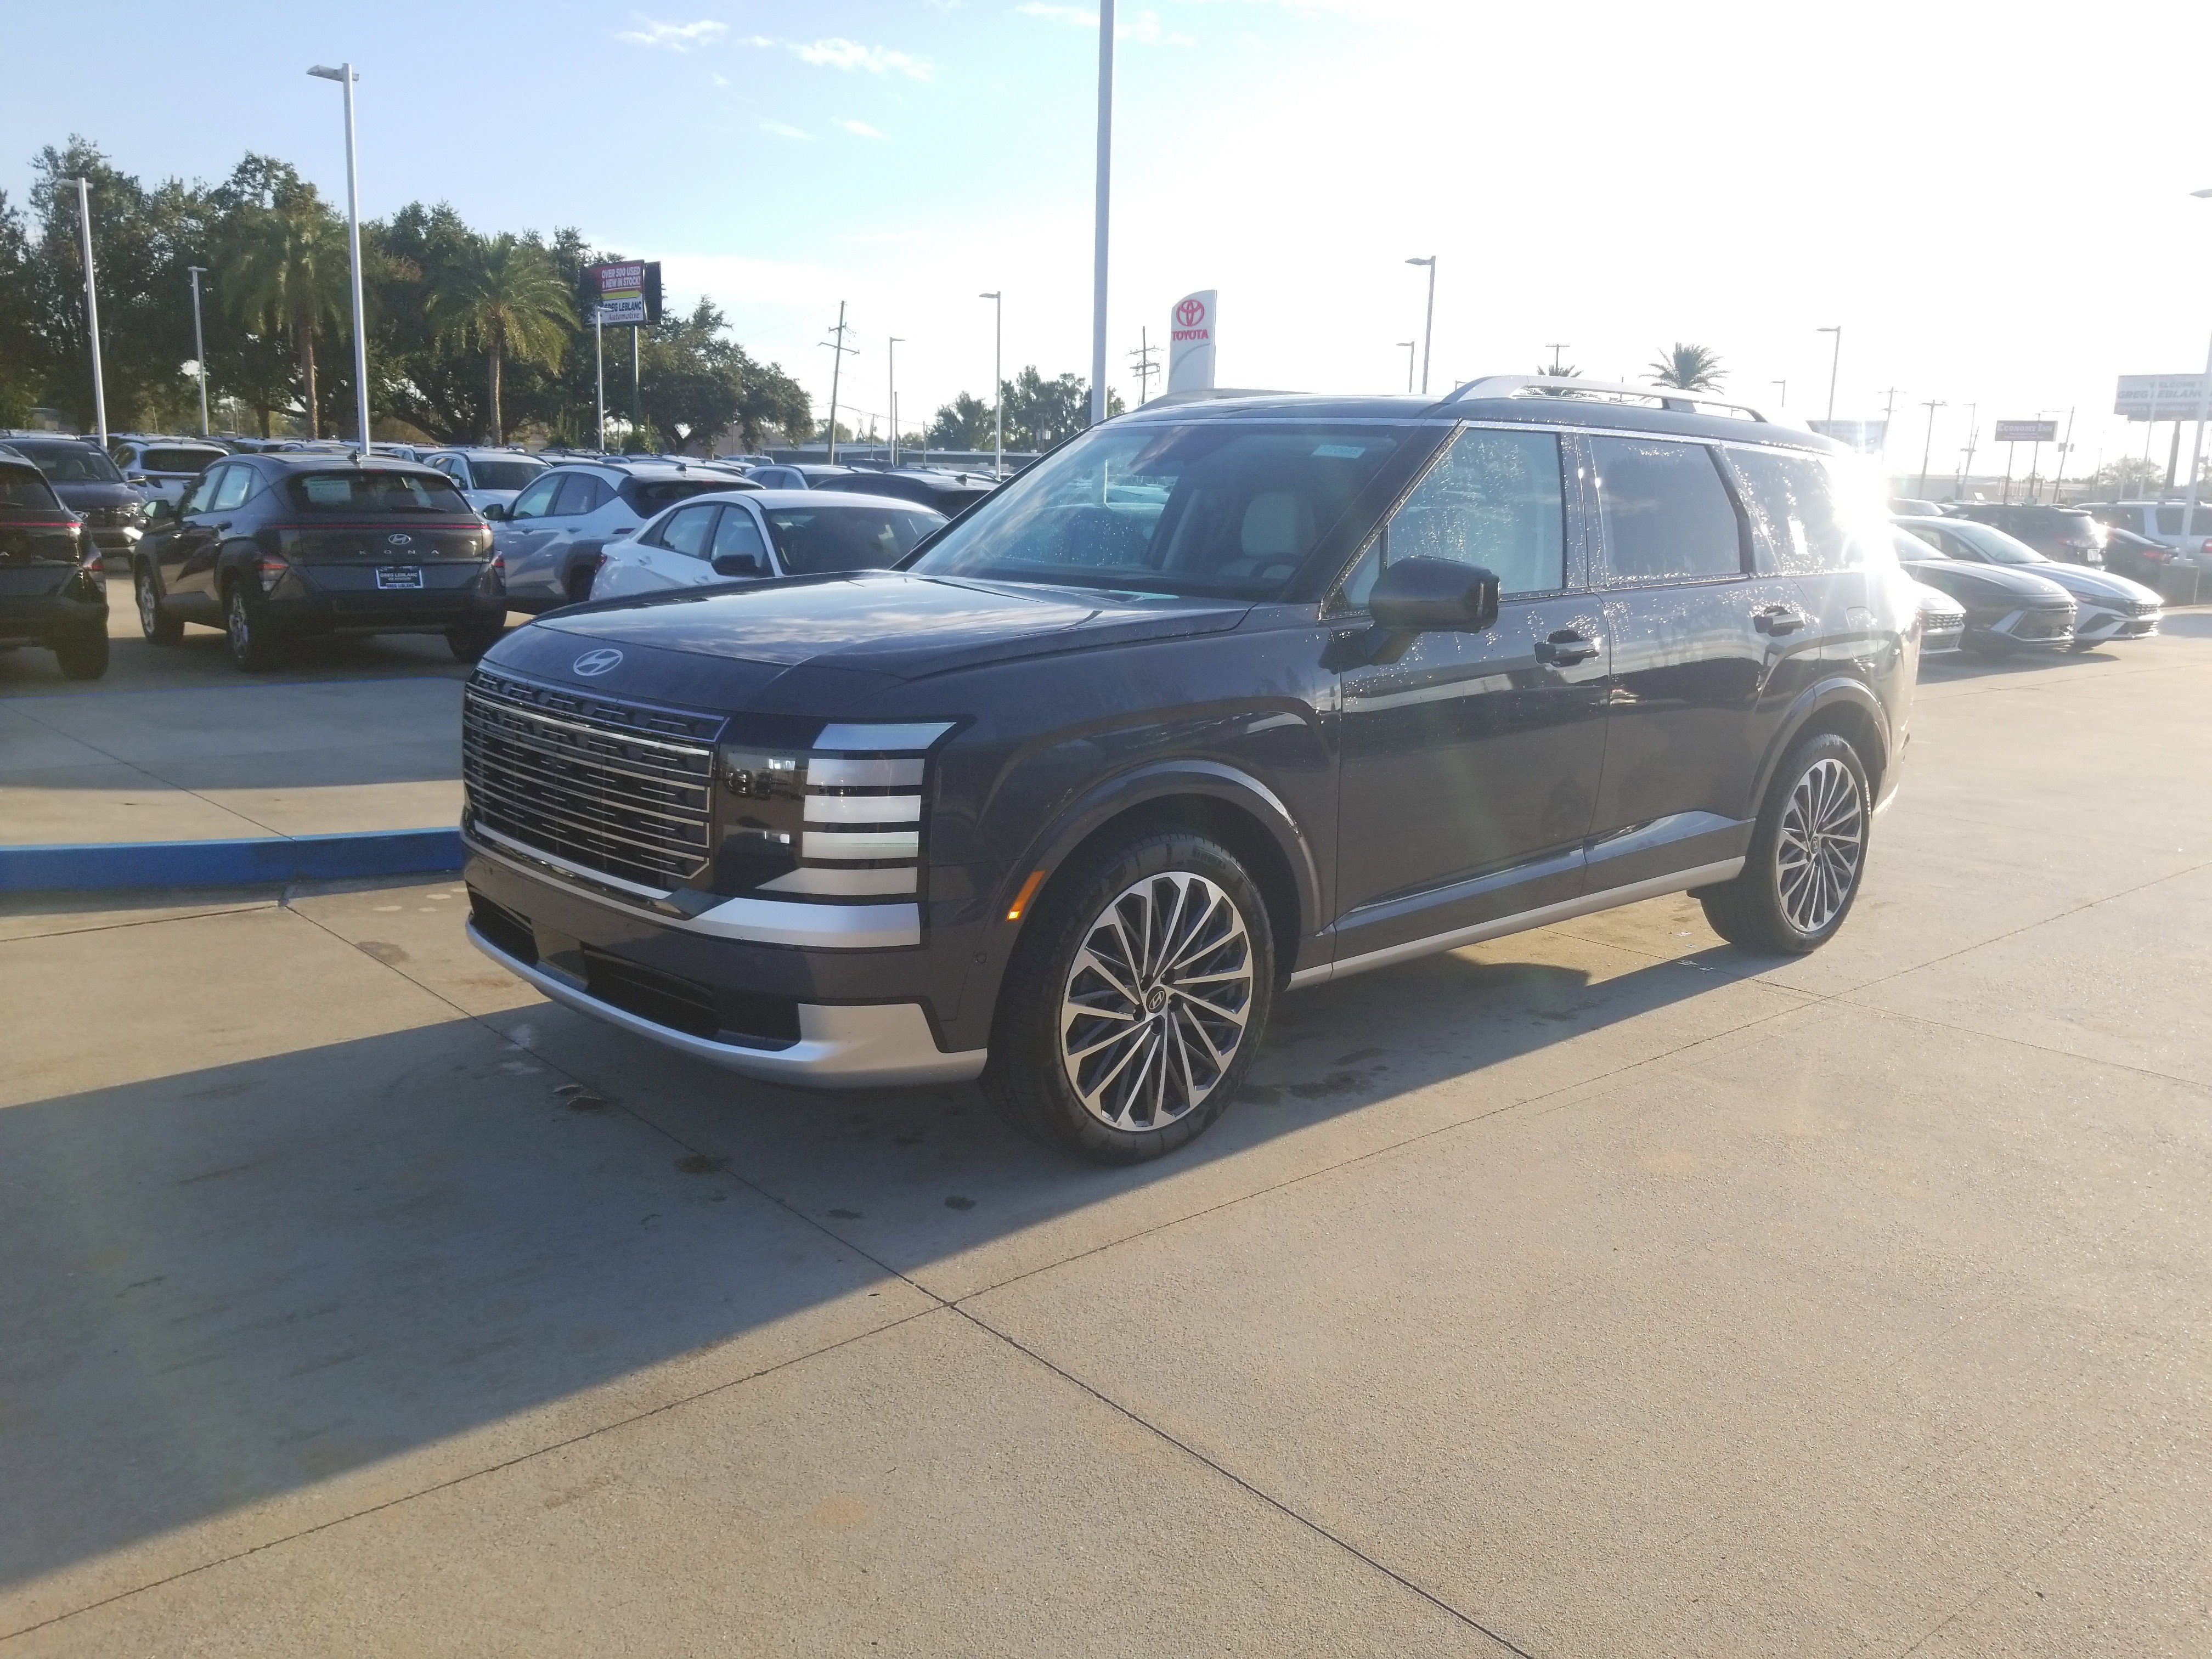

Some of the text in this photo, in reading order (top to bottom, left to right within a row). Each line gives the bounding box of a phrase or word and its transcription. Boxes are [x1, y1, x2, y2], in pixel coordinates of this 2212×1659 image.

[601, 268, 615, 279] OVER
[627, 266, 640, 276] USED
[605, 278, 617, 288] NEW
[617, 278, 623, 287] IN
[619, 301, 641, 312] LEBLANC
[1171, 329, 1209, 341] TOYOTA
[2118, 390, 2148, 398] GREG
